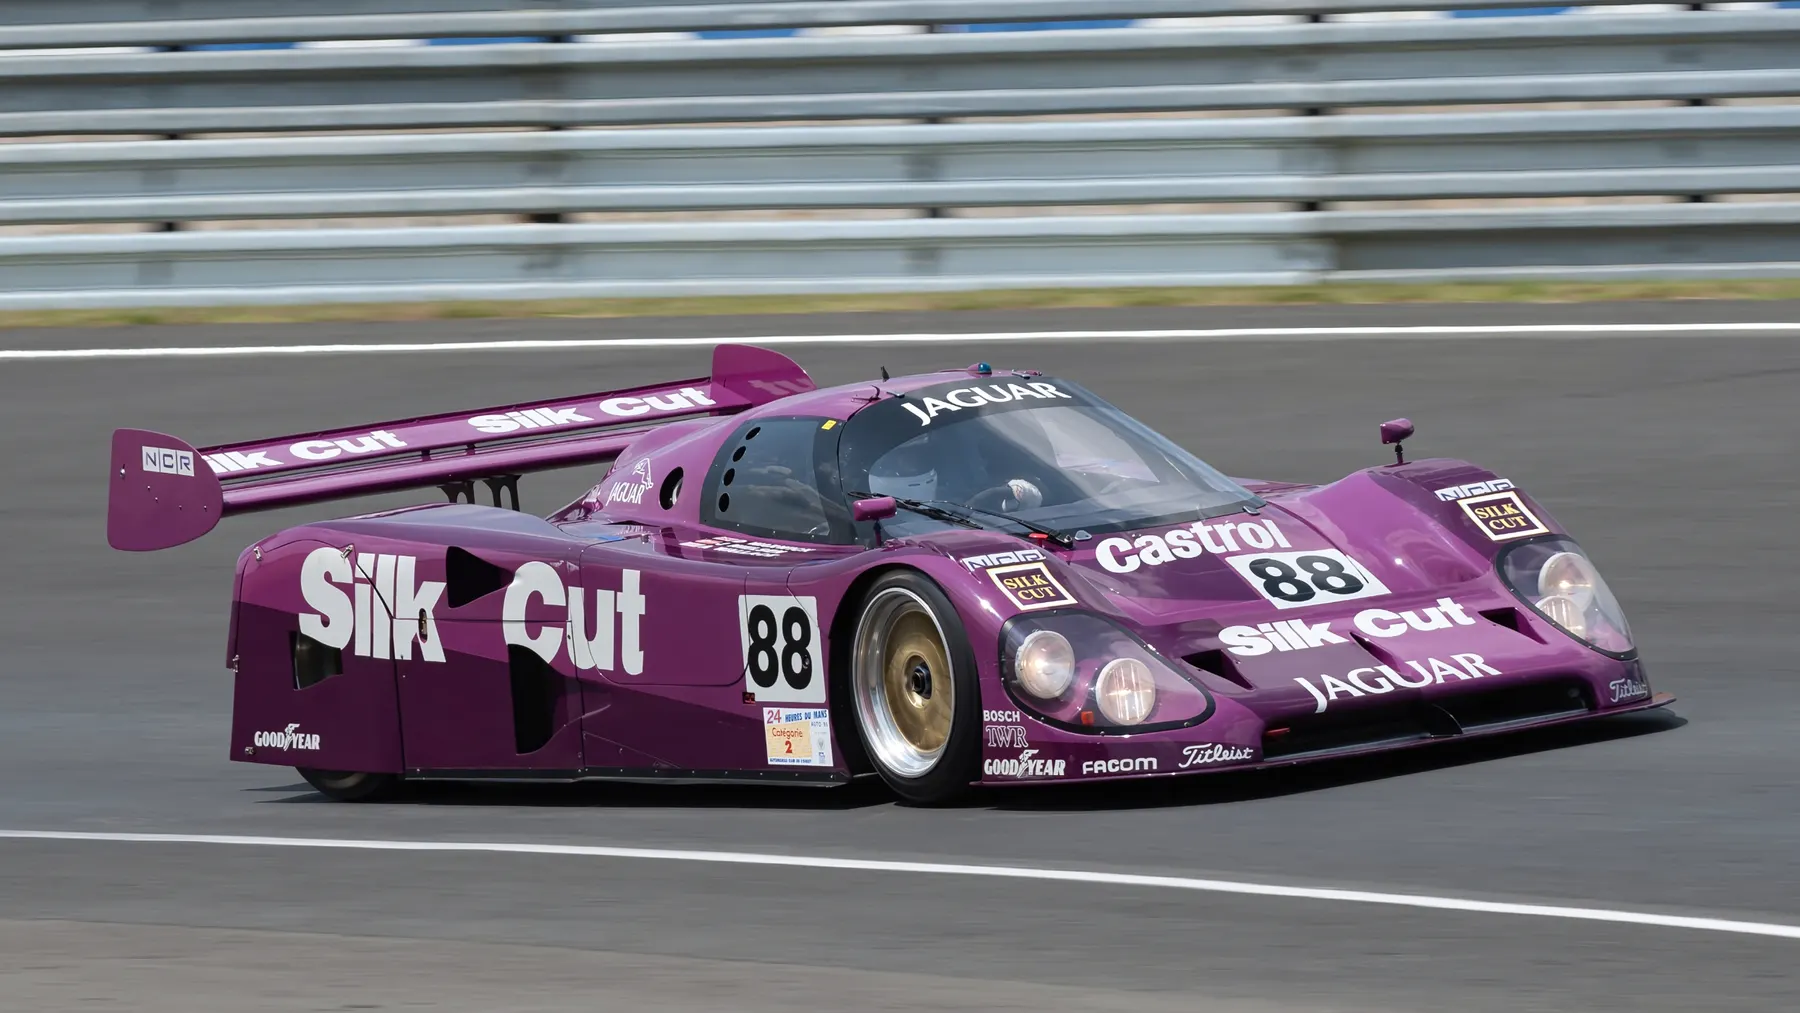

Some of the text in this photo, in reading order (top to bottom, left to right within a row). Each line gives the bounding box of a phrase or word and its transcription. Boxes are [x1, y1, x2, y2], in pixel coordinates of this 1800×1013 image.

[467, 407, 594, 433] Silk
[599, 387, 717, 417] Cut
[900, 381, 1072, 426] JAGUAR
[145, 450, 191, 472] NCR
[201, 430, 407, 473] ilk Cut
[605, 481, 645, 507] JAGUAR
[1474, 503, 1520, 519] SILK
[1489, 516, 1528, 530] CUT
[1095, 519, 1292, 574] Castrol
[1003, 574, 1049, 590] SILK
[1249, 555, 1364, 602] 88
[1017, 587, 1057, 600] CUT
[299, 547, 646, 675] Silk Cut
[1218, 597, 1476, 656] Silk Cut
[748, 604, 812, 690] 88
[1294, 653, 1503, 713] JAGUAR
[767, 709, 828, 724] 24 HEURES DU MANS
[983, 710, 1021, 722] BOSCH
[771, 727, 804, 740] Catégorie
[985, 725, 1029, 748] TWR
[784, 740, 793, 754] 2
[1178, 743, 1254, 768] Titleist
[1082, 757, 1158, 775] FACOM
